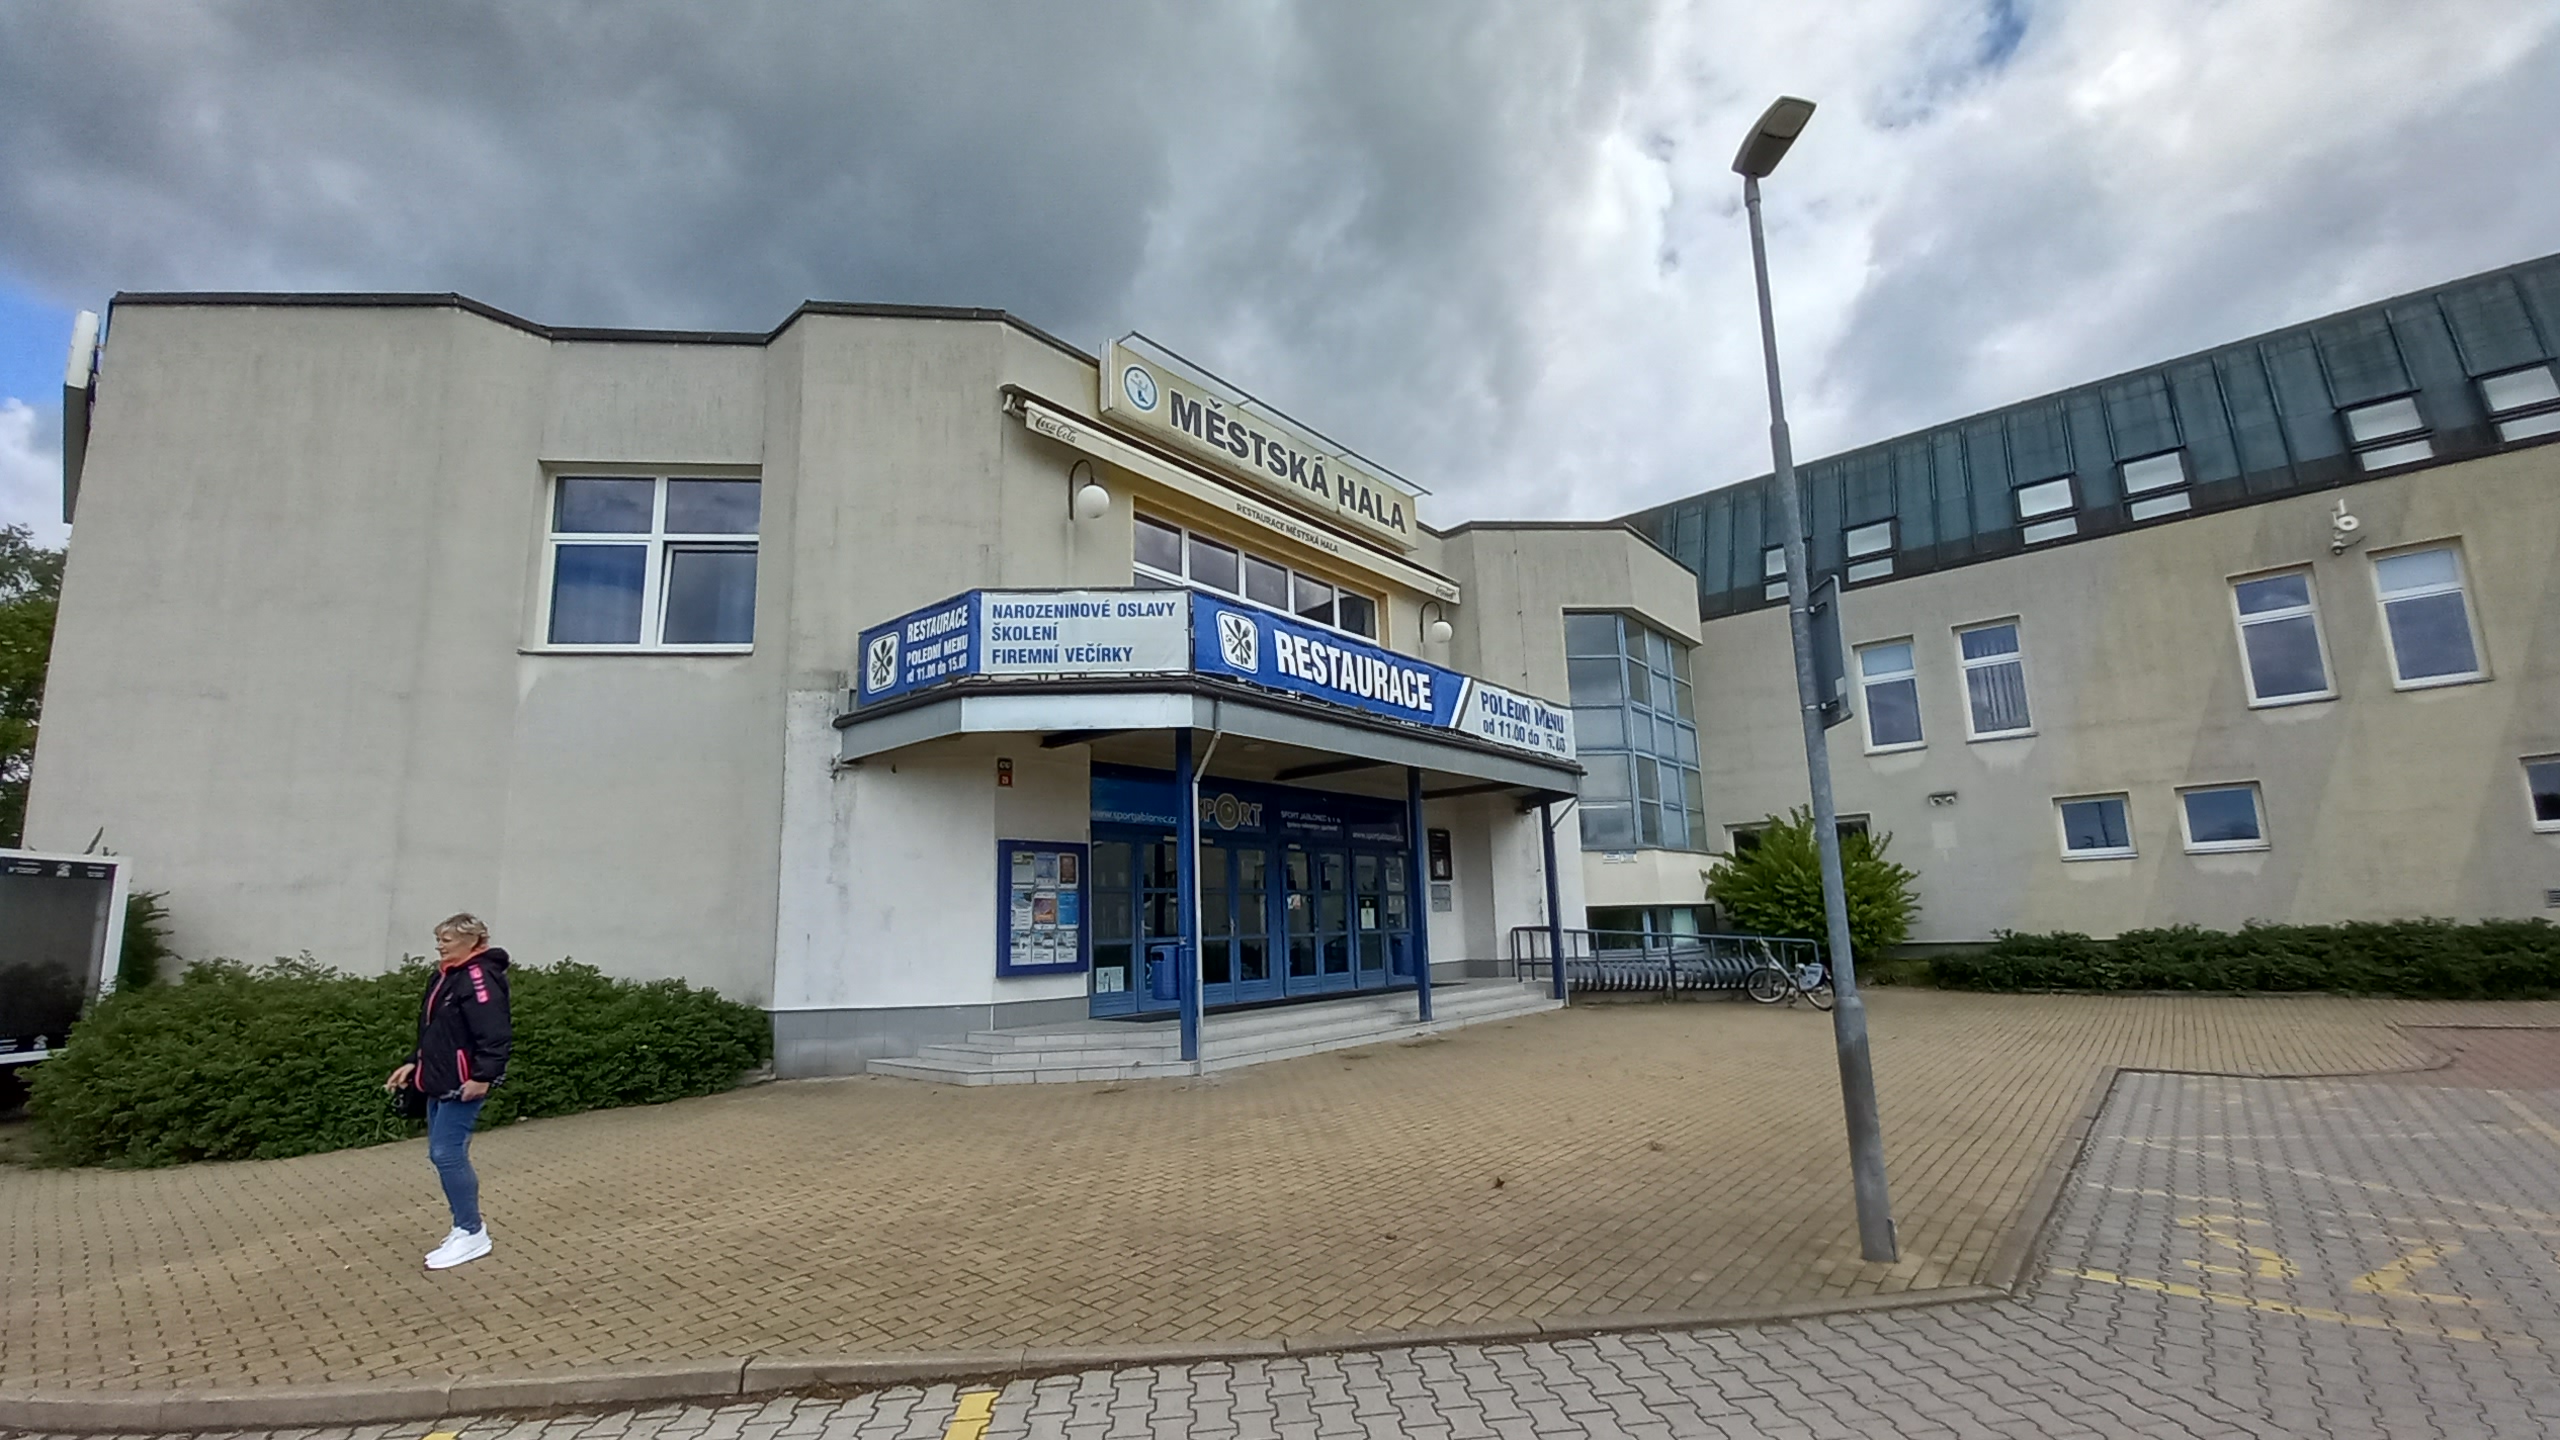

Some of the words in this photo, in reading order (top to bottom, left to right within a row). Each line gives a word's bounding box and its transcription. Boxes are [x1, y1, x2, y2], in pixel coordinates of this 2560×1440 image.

[1170, 389, 1331, 499] MĚSTSKÁ
[1337, 473, 1407, 535] HALA
[1236, 503, 1284, 531] RESTAURACE
[1285, 524, 1320, 546] MĚSTSKÁ
[1320, 539, 1339, 553] HALA
[906, 604, 968, 644] RESTAURACE
[992, 599, 1111, 619] NAROZENINOVÉ
[1116, 602, 1176, 617] OSLAVY
[991, 621, 1059, 641] ŠKOLENÍ
[906, 637, 942, 667] POLEDNÍ
[943, 633, 969, 656] MENU
[992, 643, 1060, 664] FIREMNÍ
[1065, 643, 1133, 663] VEČÍRKY
[916, 664, 936, 681] 11.00
[937, 661, 947, 676] do
[948, 652, 967, 672] 15.00
[1273, 629, 1433, 712] RESTAURACE
[1483, 718, 1495, 735] od
[1498, 720, 1526, 743] 11.00
[1528, 729, 1540, 746] do
